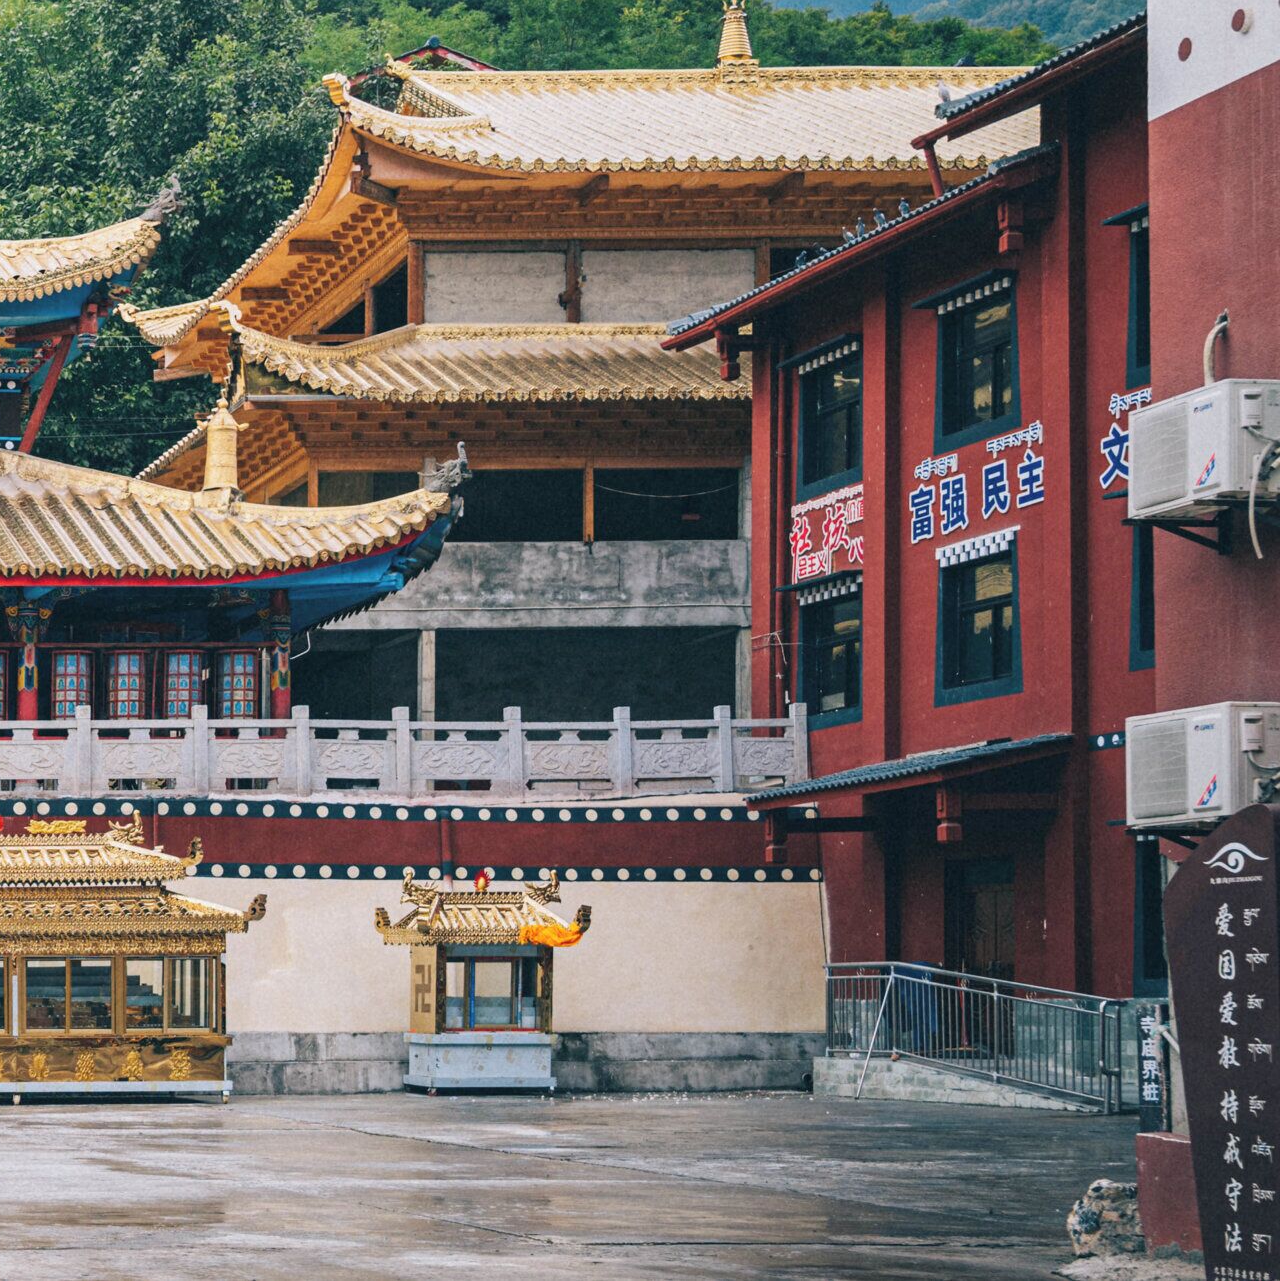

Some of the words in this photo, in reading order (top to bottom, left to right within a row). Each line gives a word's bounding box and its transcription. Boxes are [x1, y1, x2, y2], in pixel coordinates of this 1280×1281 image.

[909, 474, 969, 544] 富强
[982, 449, 1044, 519] 民主
[1100, 422, 1128, 489] 文
[1140, 1016, 1161, 1102] 寺庙界桩
